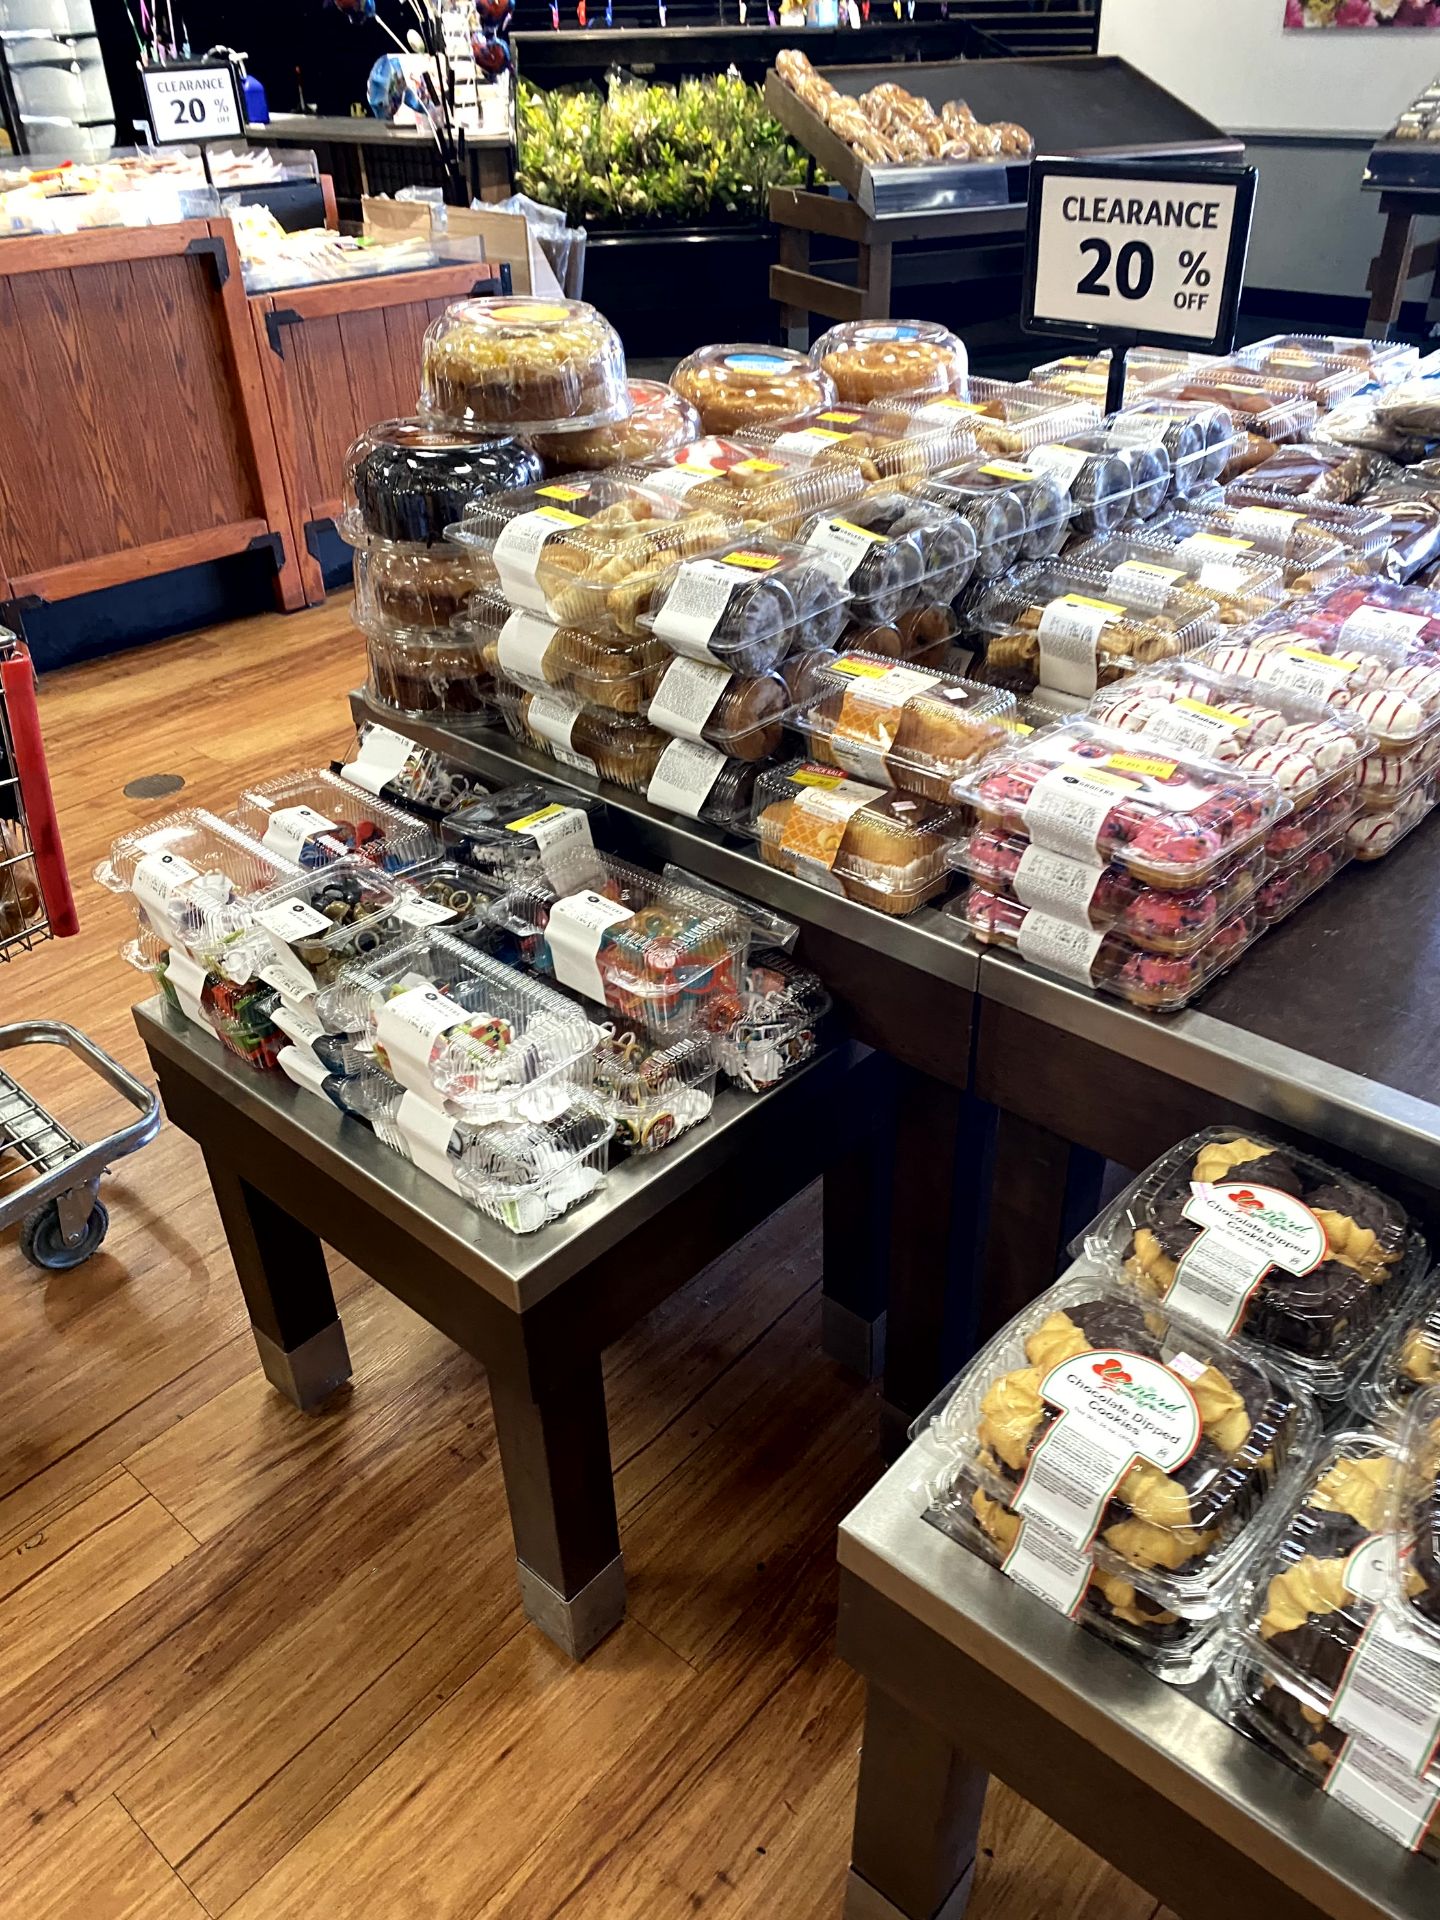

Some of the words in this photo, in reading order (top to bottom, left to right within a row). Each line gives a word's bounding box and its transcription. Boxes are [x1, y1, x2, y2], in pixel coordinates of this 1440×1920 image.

[157, 77, 225, 93] CLEARANCE
[169, 97, 206, 124] 20
[213, 98, 229, 113] %
[1062, 196, 1220, 229] CLEARANCE
[1076, 237, 1154, 300] 20
[1178, 250, 1211, 287] %
[1173, 292, 1210, 310] OFF
[806, 766, 827, 775] QUICK
[1206, 1200, 1264, 1234] Chocolate
[1266, 1231, 1311, 1256] Dipped
[1226, 1221, 1275, 1249] Cookies
[1066, 1373, 1130, 1416] Chocolate
[1132, 1412, 1181, 1445] Dipped
[1088, 1400, 1141, 1436] Cookies
